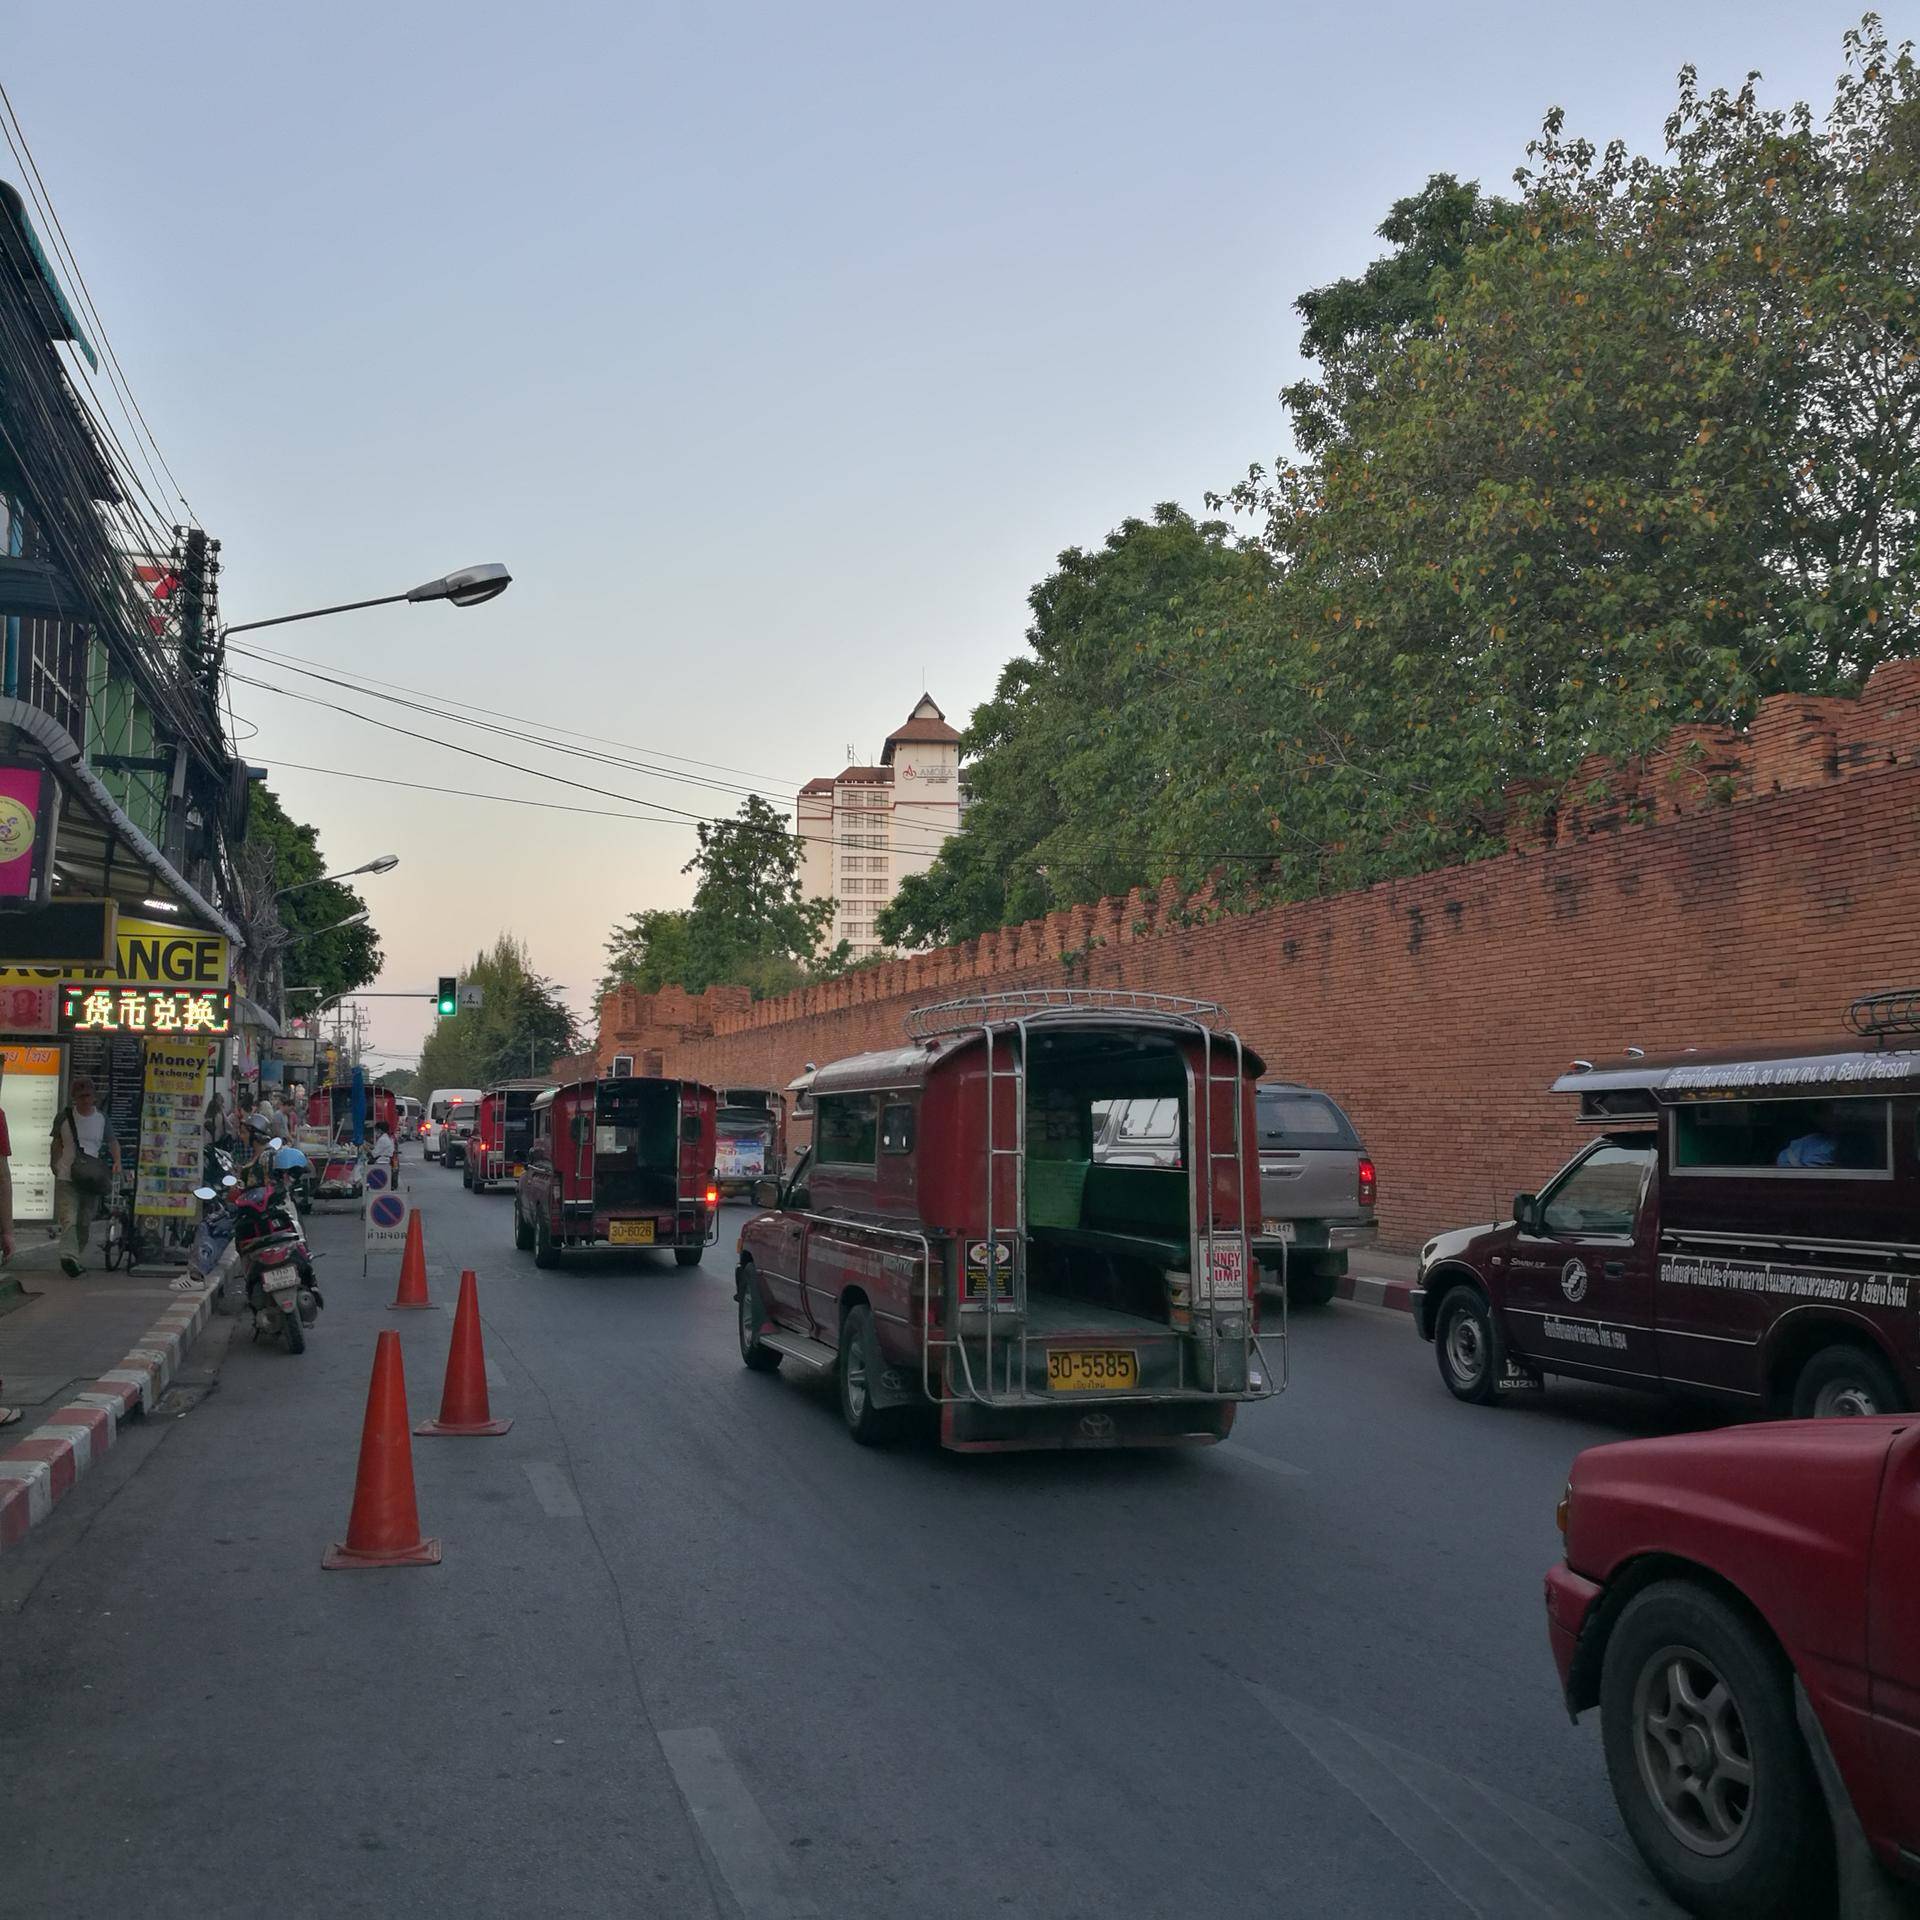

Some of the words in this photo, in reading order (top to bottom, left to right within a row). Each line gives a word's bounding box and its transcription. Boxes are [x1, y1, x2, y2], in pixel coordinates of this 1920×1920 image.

[83, 996, 214, 1027] 货币兑换
[149, 1052, 206, 1070] Money
[153, 1068, 200, 1080] Exchange
[1760, 1069, 1773, 1086] 30
[1821, 1065, 1835, 1082] 30
[1837, 1060, 1911, 1081] Baht/Person
[1850, 1282, 1859, 1302] 2
[1861, 1274, 1910, 1308] เชียงใหม่
[1050, 1352, 1129, 1378] 30-5585
[1500, 1380, 1538, 1389] ISUZU
